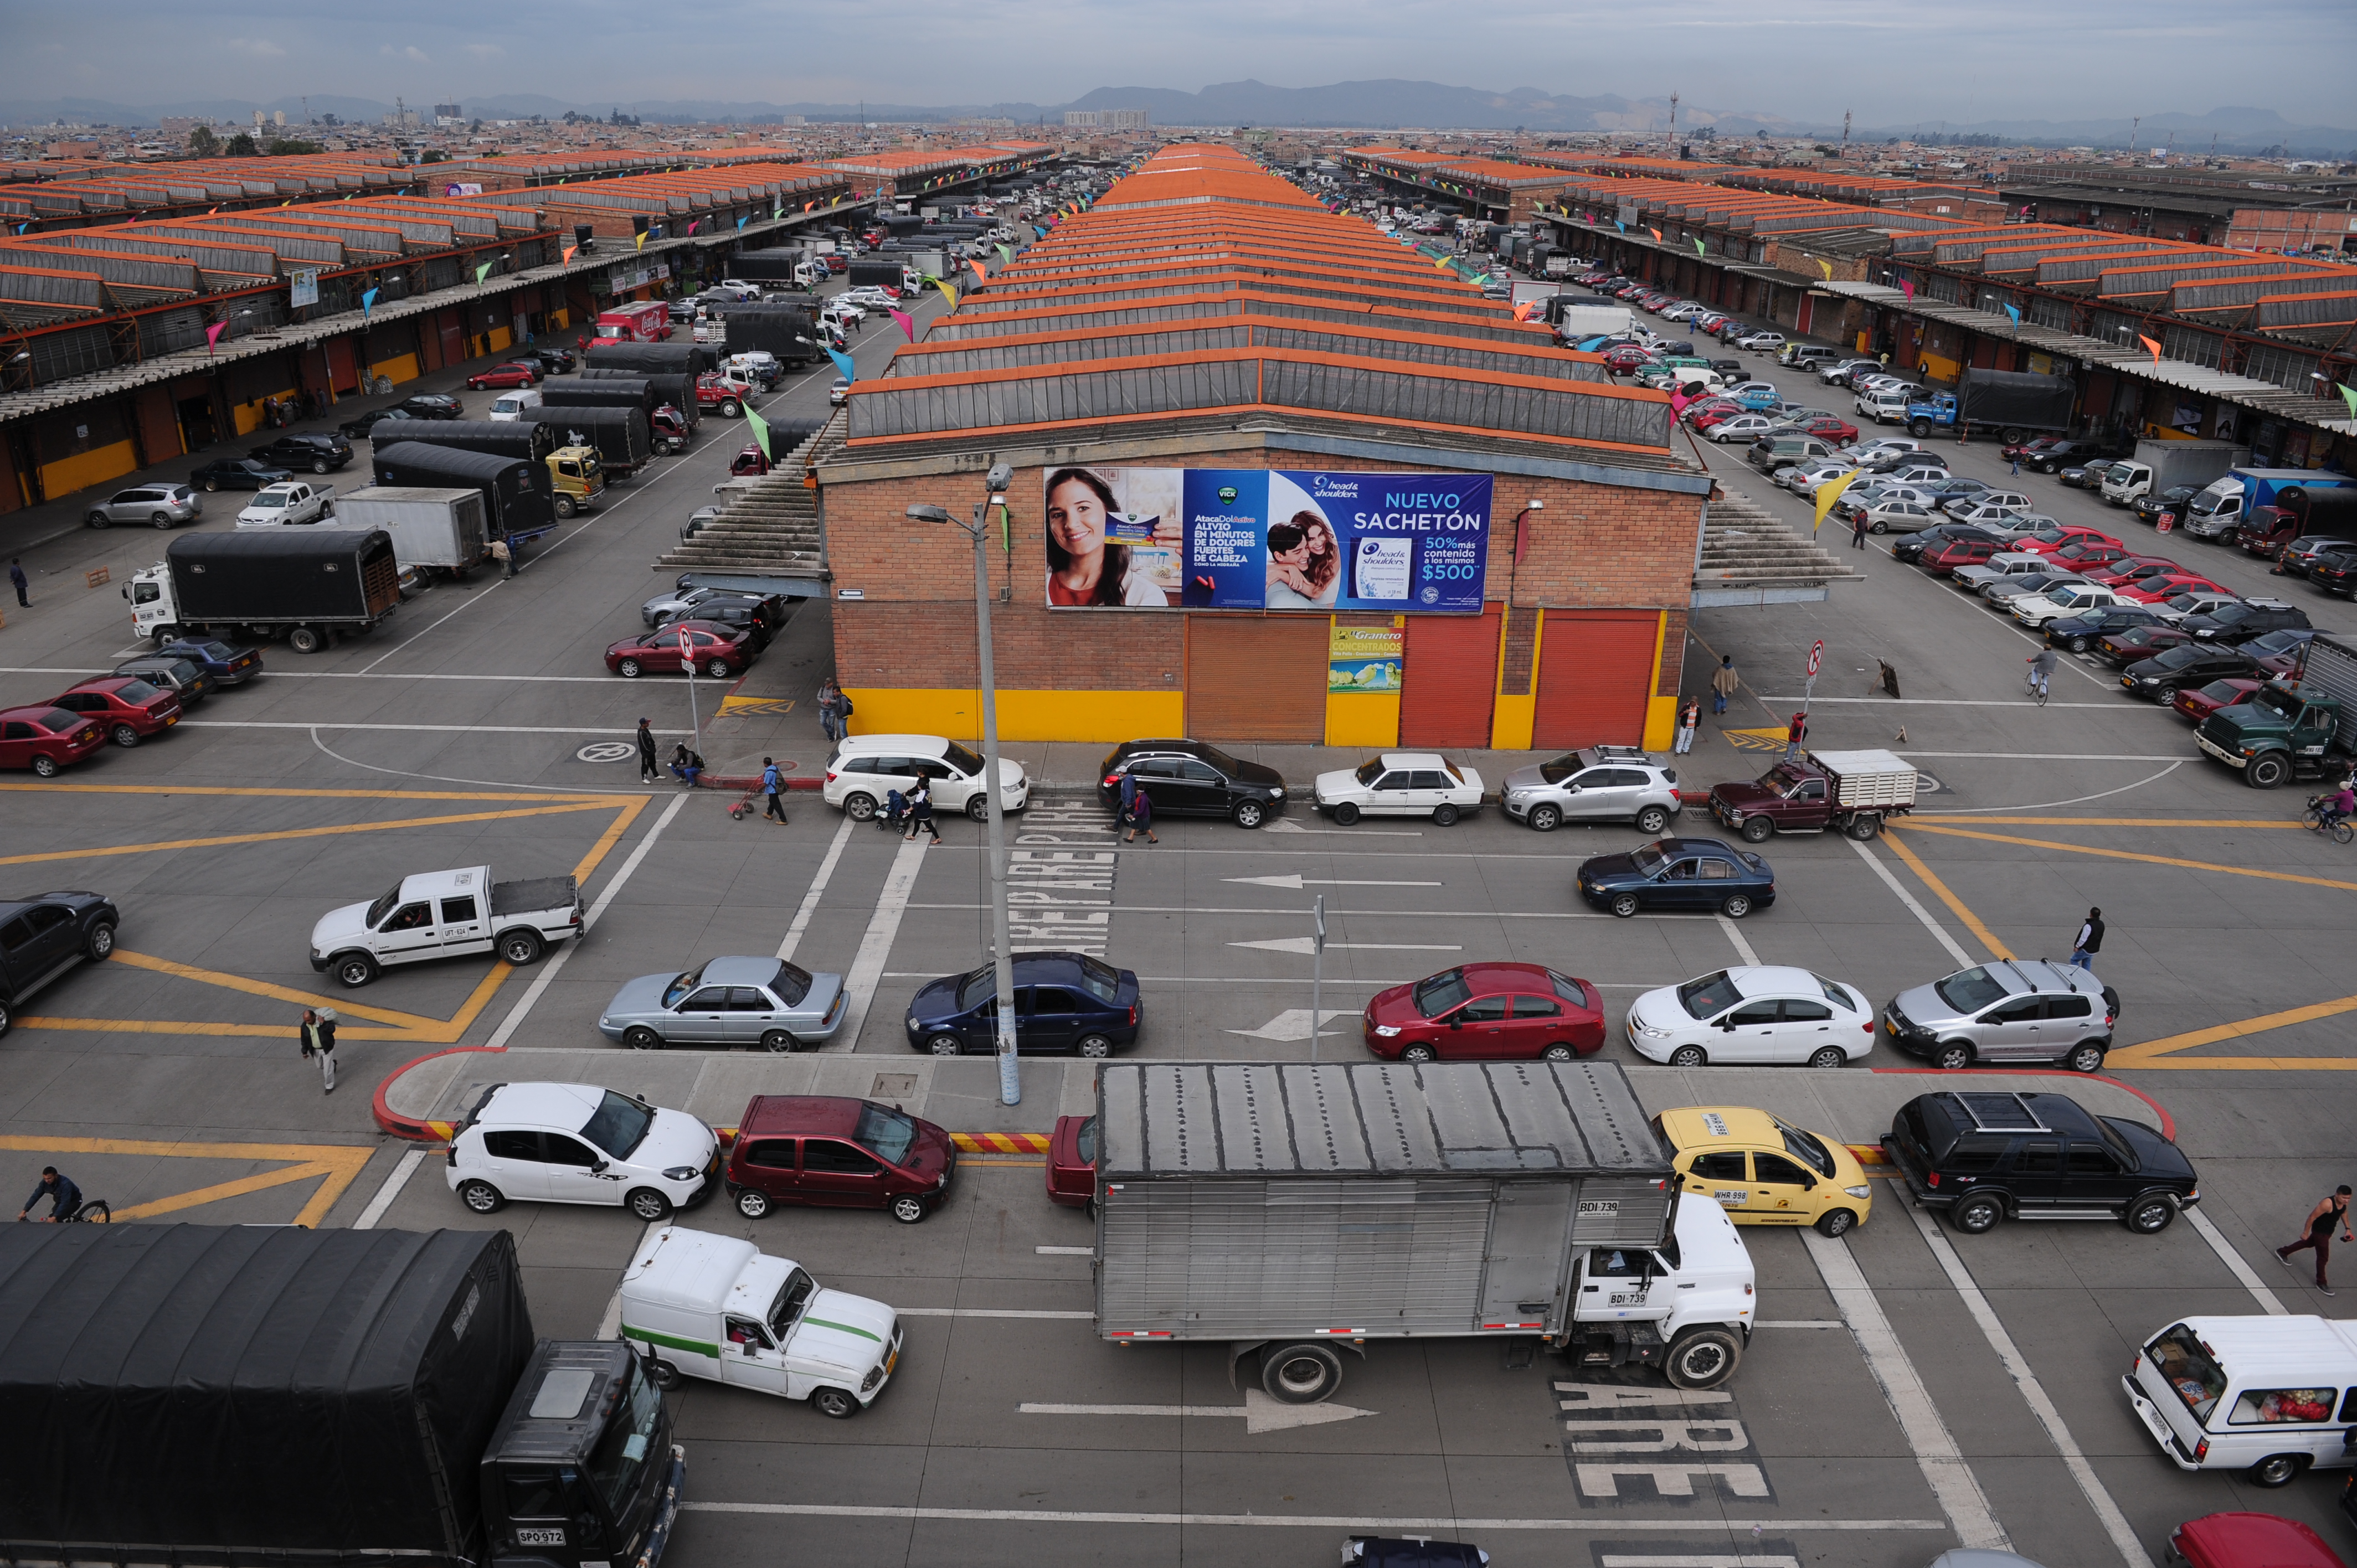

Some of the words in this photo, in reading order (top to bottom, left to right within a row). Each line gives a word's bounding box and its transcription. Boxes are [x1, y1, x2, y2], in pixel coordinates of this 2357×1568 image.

[1314, 489, 1358, 498] shoulders
[1386, 493, 1460, 509] NUEVO
[1354, 509, 1480, 530] SACHETÓN
[1424, 549, 1475, 558] contenido
[1355, 630, 1402, 639] Granero
[1332, 642, 1402, 652] CONCENTRADOS
[1006, 851, 1115, 905] PARE
[1554, 1381, 1771, 1497] ARE
